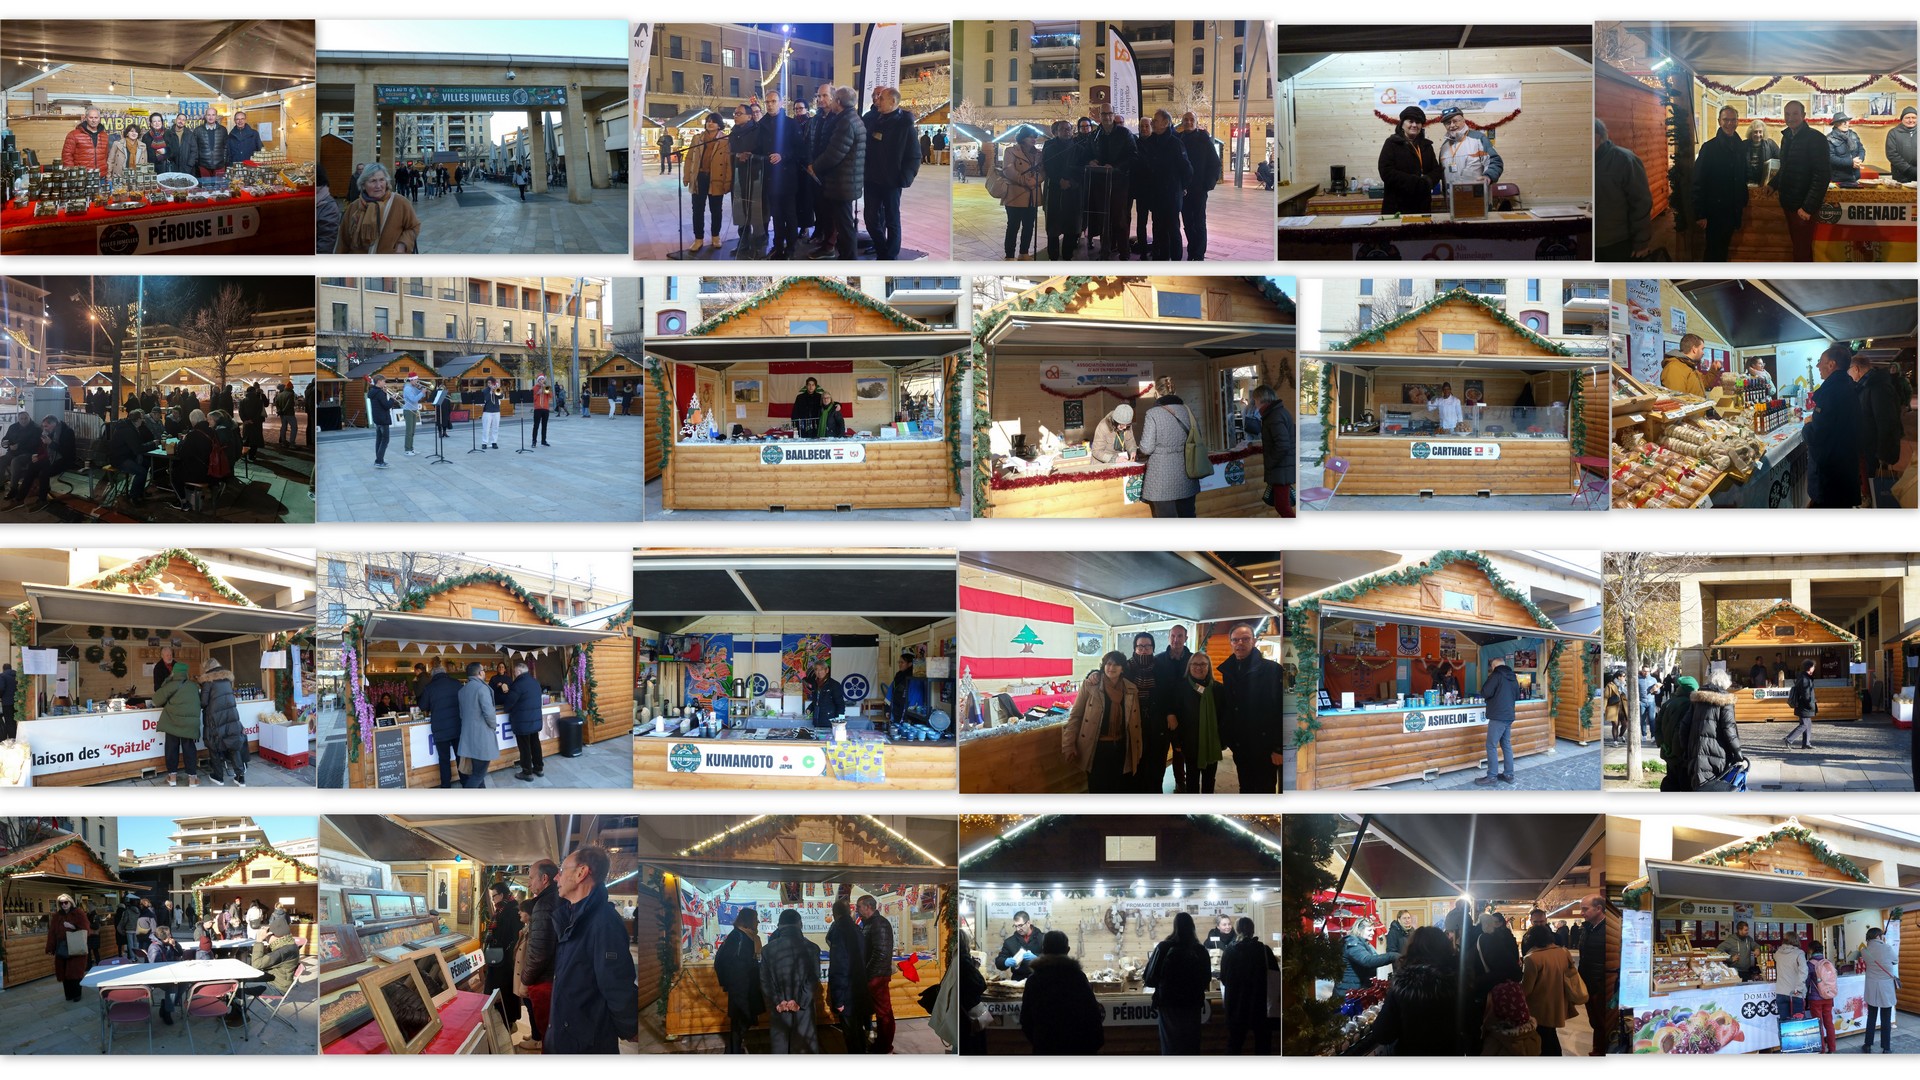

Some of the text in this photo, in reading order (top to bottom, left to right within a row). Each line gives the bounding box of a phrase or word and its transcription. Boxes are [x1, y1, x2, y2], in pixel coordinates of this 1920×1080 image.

[442, 94, 510, 102] VILLES JUMELLES
[1848, 205, 1906, 220] GRENADE
[148, 219, 212, 245] PÉROUSE
[218, 226, 233, 236] ITALIE
[786, 449, 831, 460] BAALBECK
[1432, 446, 1472, 456] CARTHAGE
[142, 719, 158, 731] De
[1428, 713, 1467, 726] ASHKELON
[78, 747, 100, 760] des
[706, 753, 773, 768] KUMAMOTO
[450, 958, 472, 979] PÉROUSE
[1744, 992, 1776, 1000] DOMAIN
[1112, 1003, 1158, 1020] PÉROUS
